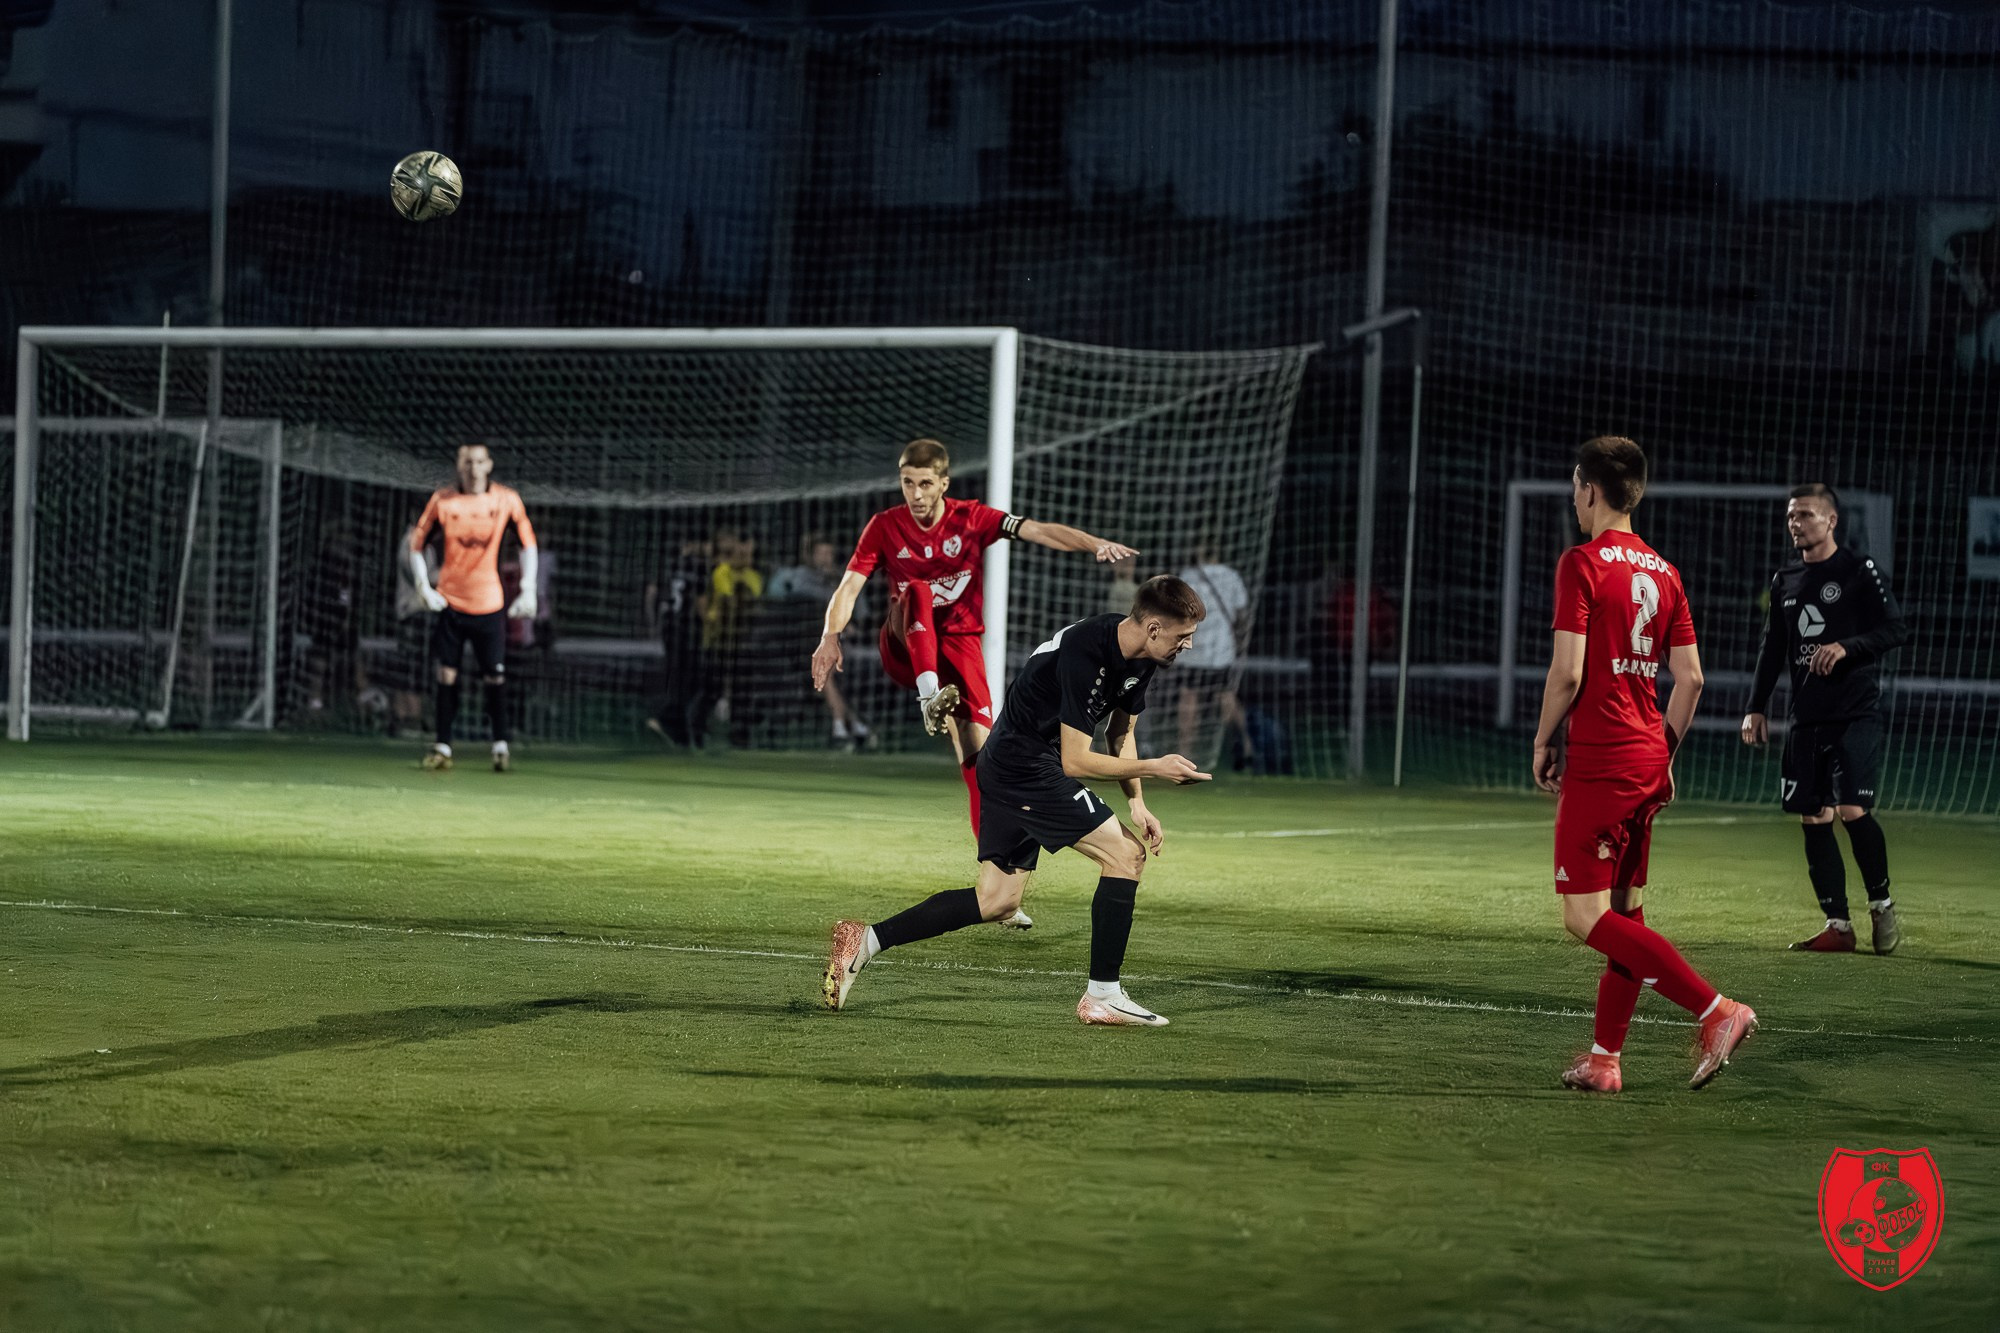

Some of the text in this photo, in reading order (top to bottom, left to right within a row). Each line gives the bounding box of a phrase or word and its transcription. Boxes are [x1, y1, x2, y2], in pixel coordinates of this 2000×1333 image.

[1599, 546, 1626, 562] ФК
[1631, 572, 1660, 656] 2
[1073, 787, 1106, 813] 7
